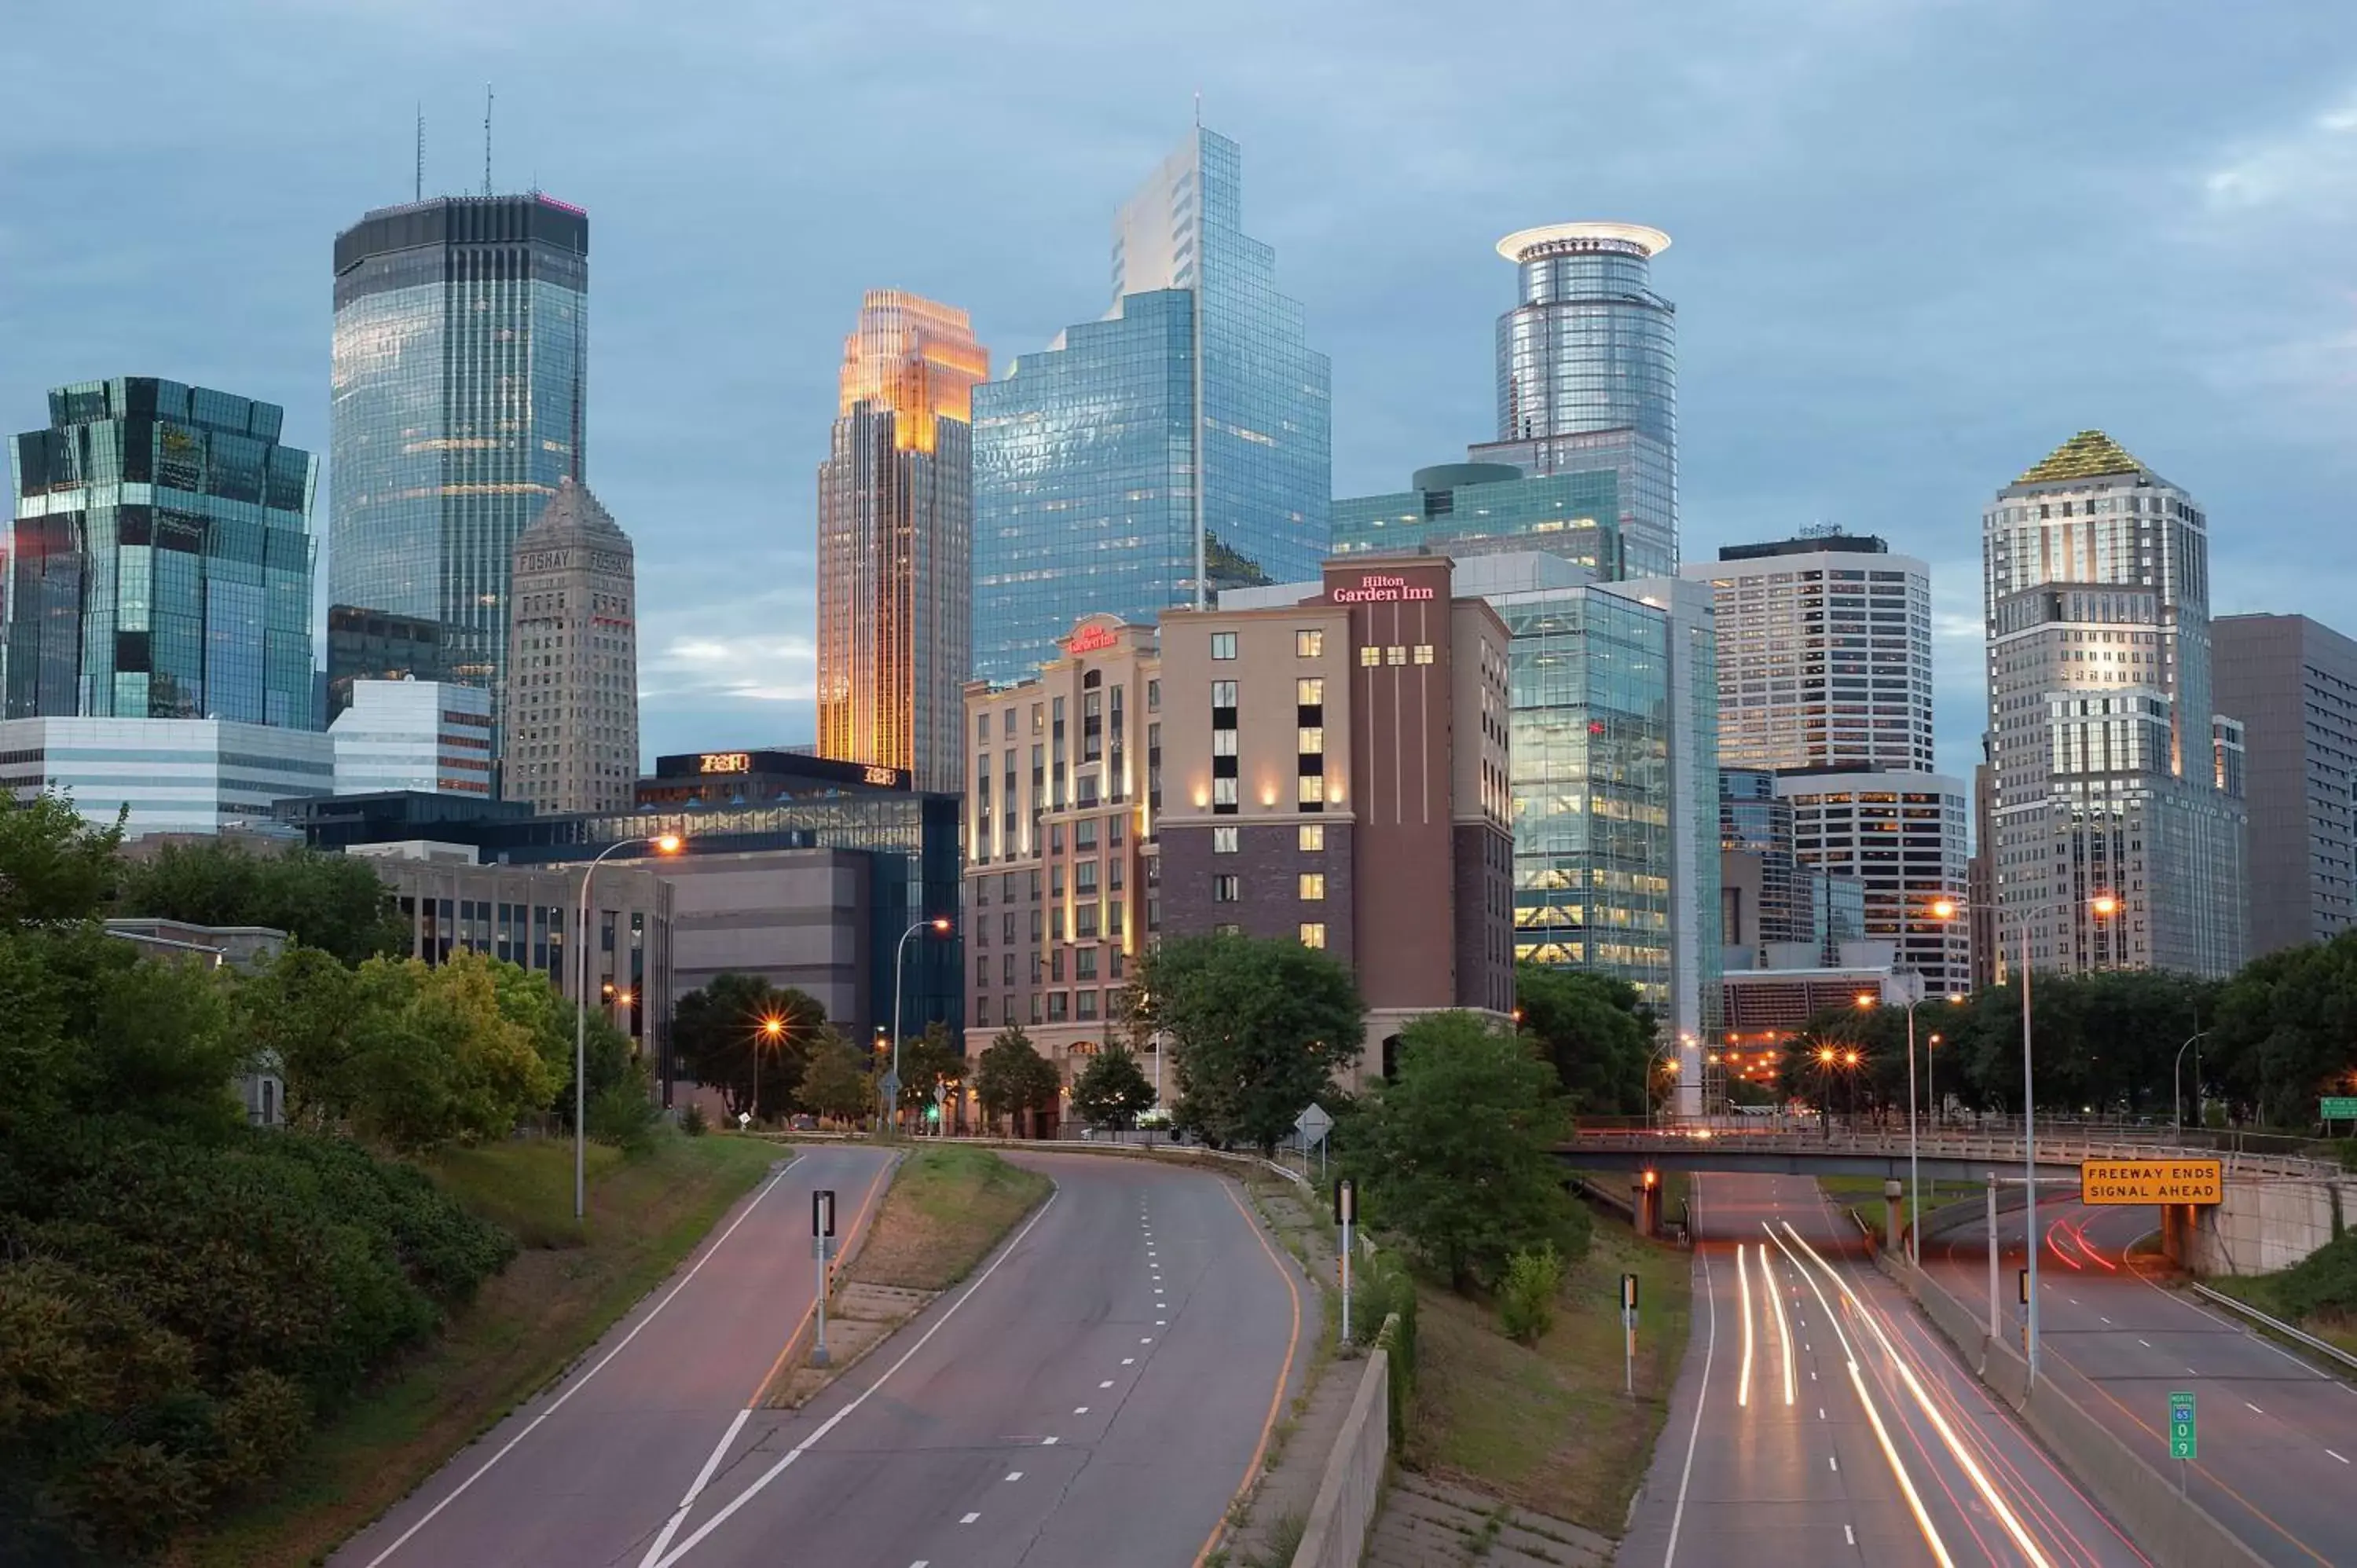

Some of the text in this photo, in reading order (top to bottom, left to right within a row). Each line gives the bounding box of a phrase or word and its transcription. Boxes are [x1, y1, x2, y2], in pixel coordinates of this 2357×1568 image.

[520, 551, 570, 572] FOSHAY
[1362, 575, 1404, 588] Hilton
[1333, 585, 1434, 603] Garden Inn
[2088, 1168, 2214, 1179] FREEWAY ENDS
[2090, 1185, 2213, 1196] SIGNAL AHEAD
[2176, 1410, 2188, 1420] 65
[2178, 1423, 2188, 1437] 0
